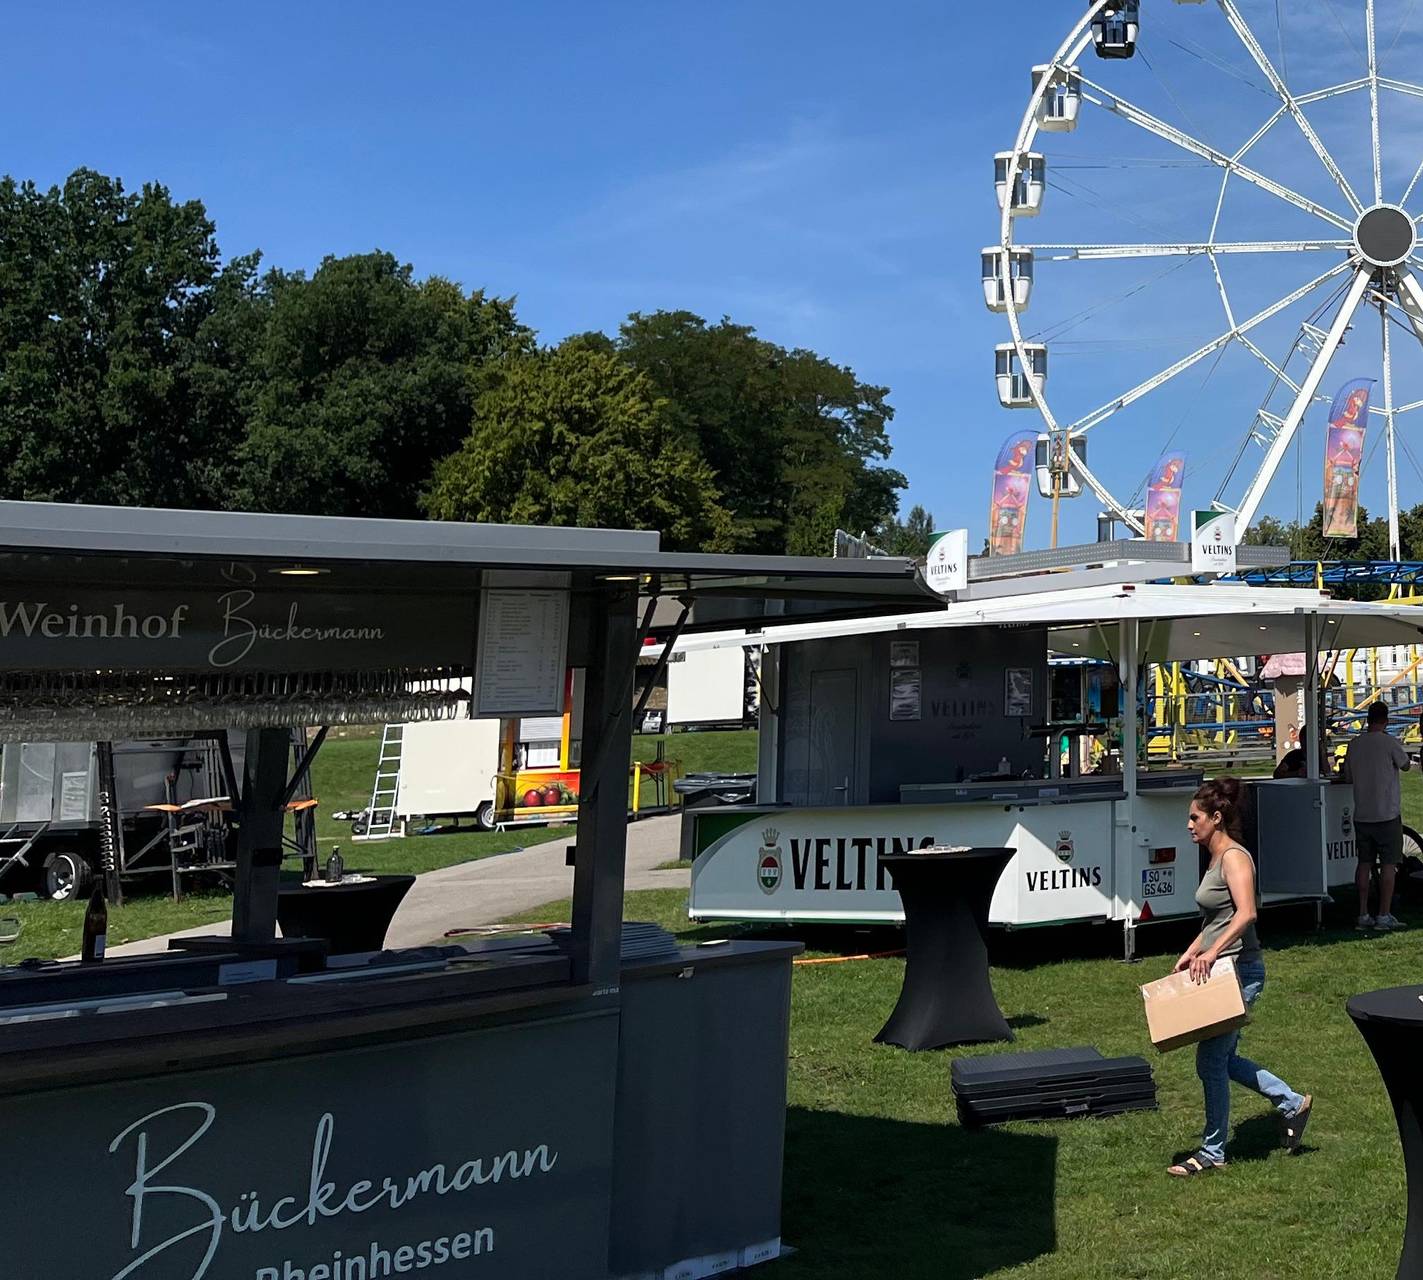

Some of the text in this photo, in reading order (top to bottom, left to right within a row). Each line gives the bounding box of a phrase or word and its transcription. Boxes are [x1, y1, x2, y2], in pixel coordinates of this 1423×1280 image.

[1202, 544, 1233, 556] VELTINS
[930, 563, 958, 575] VELTINS
[0, 589, 384, 667] Weinhof Bückermann
[1026, 866, 1102, 892] VELTINS
[1148, 870, 1160, 883] SO
[1144, 881, 1173, 896] GS 436
[109, 1101, 558, 1280] Bückermann
